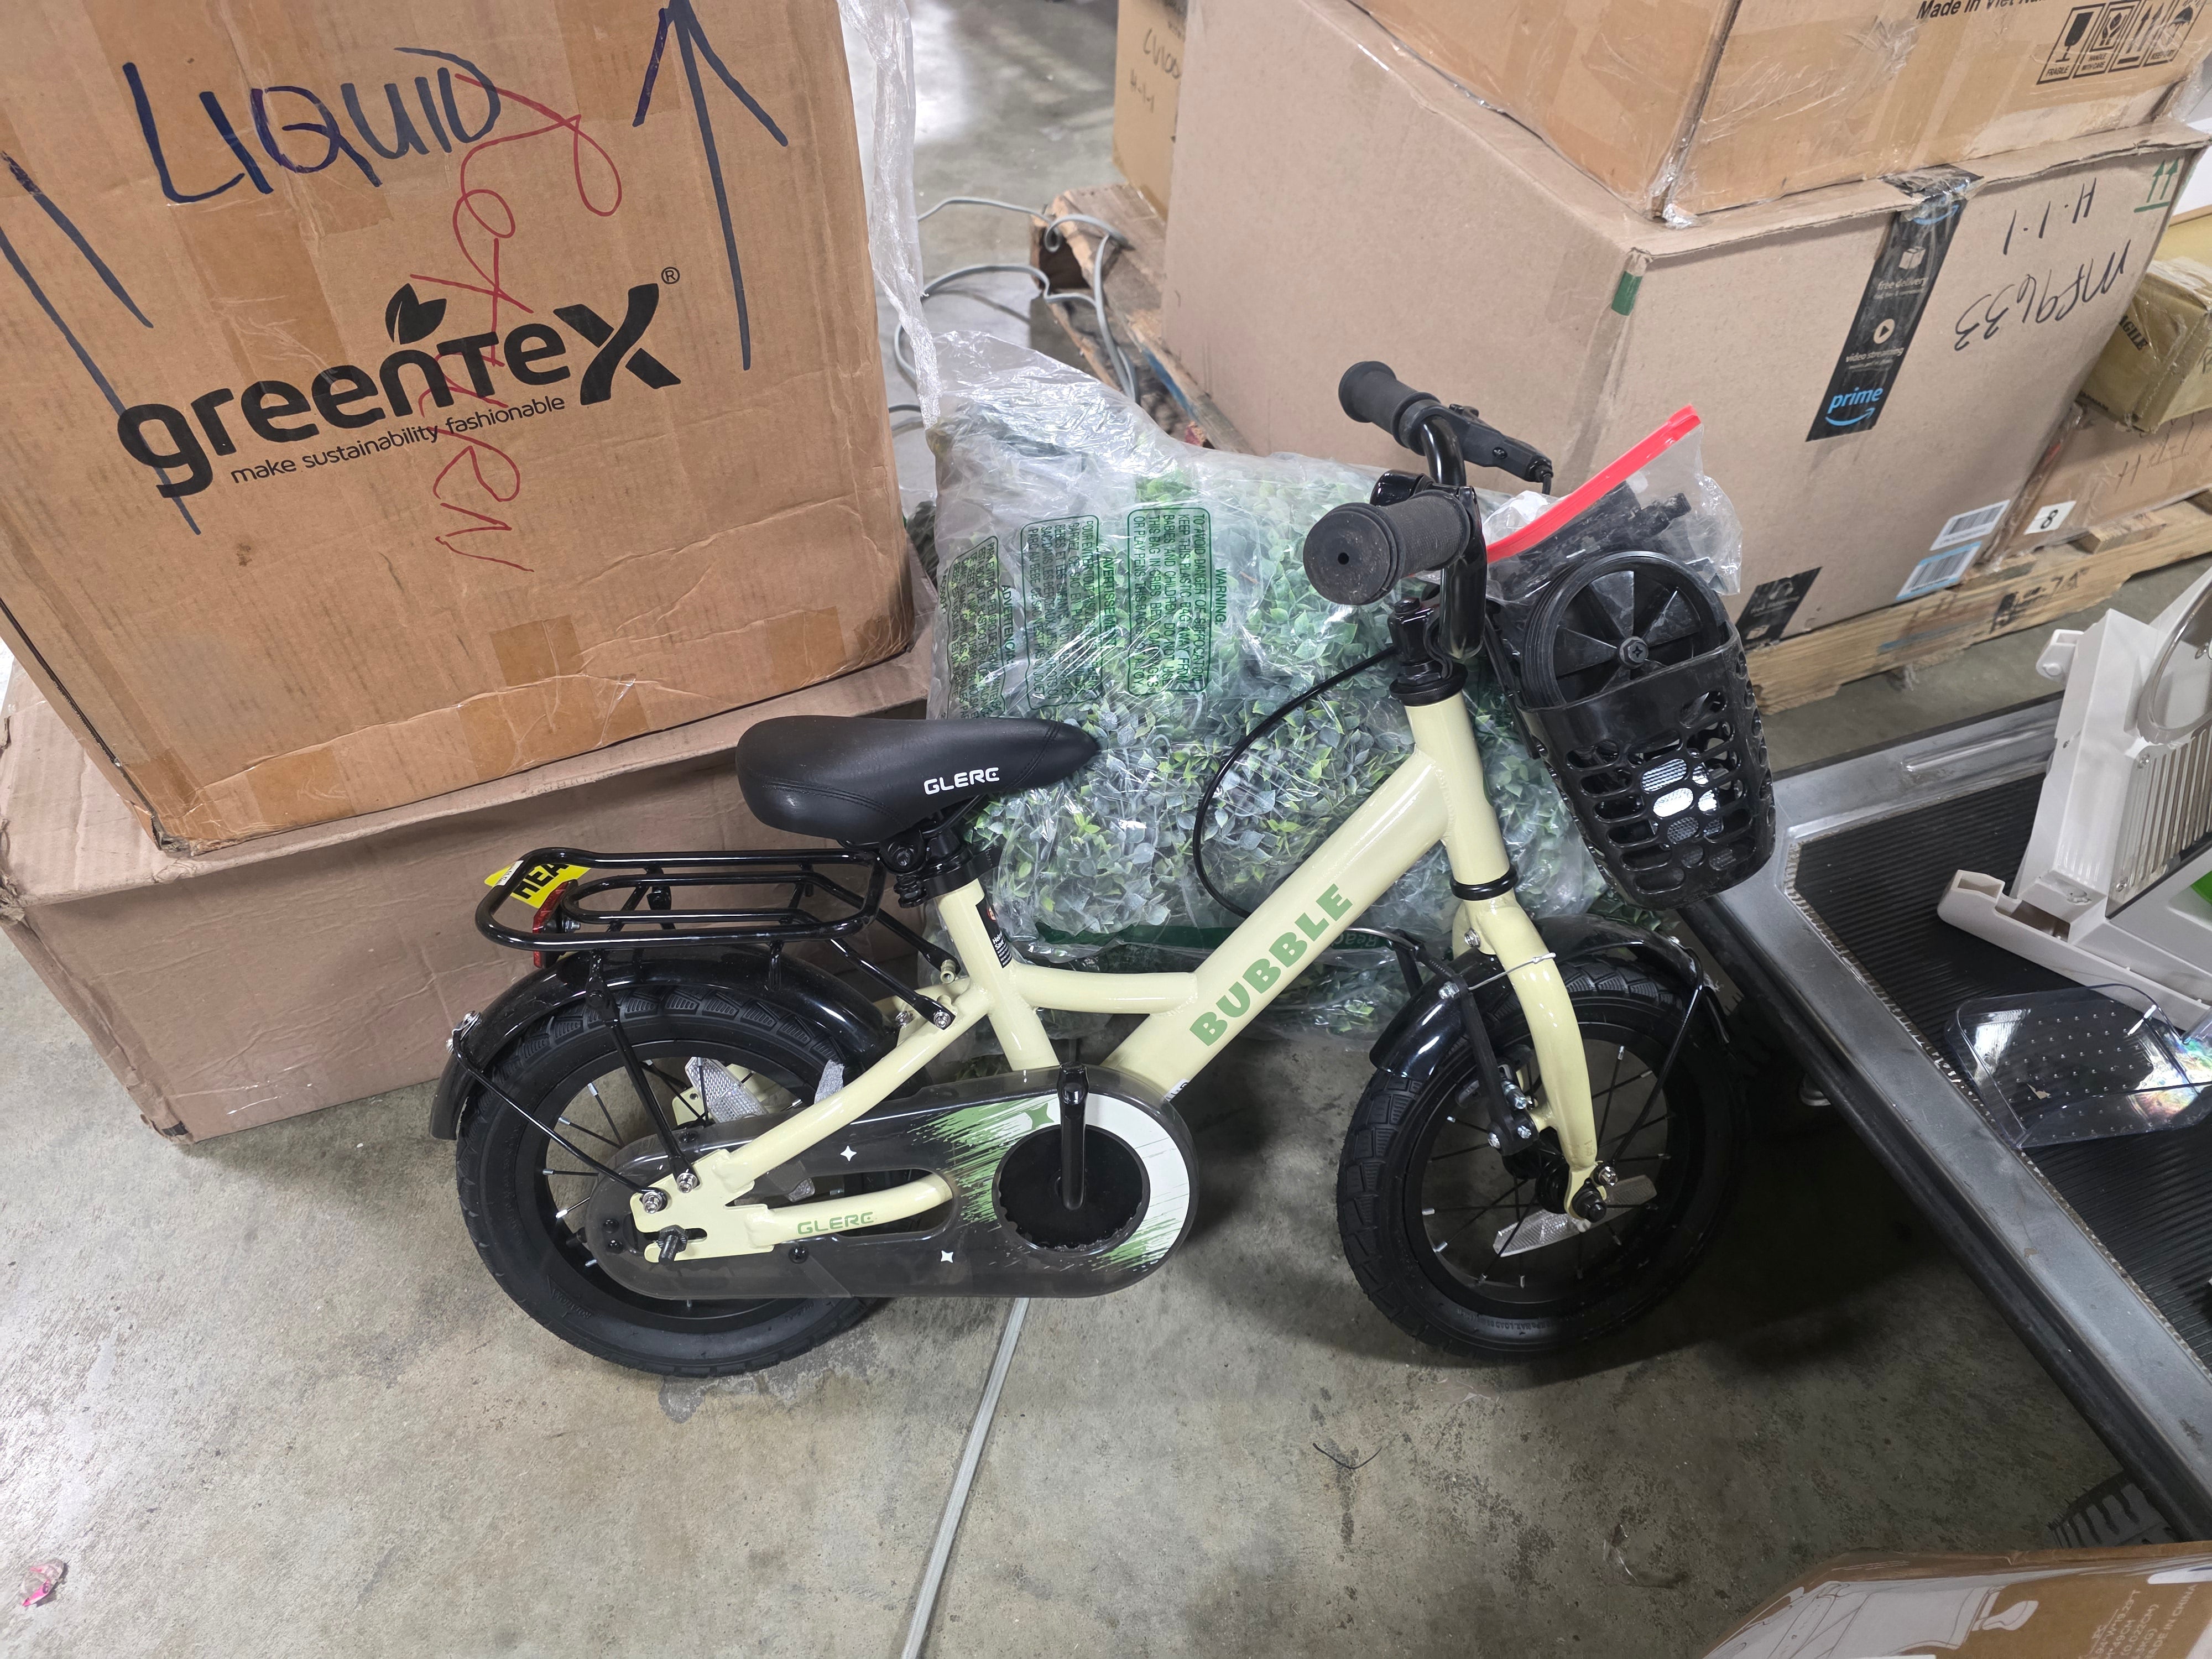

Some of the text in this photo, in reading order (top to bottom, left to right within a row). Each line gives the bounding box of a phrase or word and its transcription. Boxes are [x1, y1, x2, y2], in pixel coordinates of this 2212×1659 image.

[1916, 1, 1961, 19] Made
[2047, 65, 2070, 76] FRAGILE
[122, 46, 502, 205] LIQUID
[1845, 352, 1866, 363] video
[1827, 387, 1884, 414] prime
[230, 394, 566, 484] make sustainability fashionable
[1134, 517, 1145, 528] OR
[1149, 515, 1160, 534] THIS
[1193, 514, 1205, 524] TO
[2039, 509, 2059, 530] 8
[1041, 526, 1052, 541] SAC
[1068, 523, 1079, 551] GARDEZ
[1082, 521, 1093, 541] POUR
[1164, 515, 1175, 544] BABIES
[1028, 529, 1039, 550] PARC
[1134, 531, 1145, 550] PLAY
[1149, 537, 1160, 554] BAG
[1194, 529, 1206, 555] AVOID
[978, 547, 986, 566] ESTA
[1041, 543, 1053, 565] DANS
[1056, 551, 1066, 561] ET
[1069, 556, 1080, 567] CE
[1149, 559, 1160, 567] IN
[1164, 549, 1176, 566] AND
[986, 562, 995, 589] EVITAR
[1042, 566, 1053, 580] LES
[1056, 565, 1067, 580] LES
[1134, 554, 1145, 579] PENS.
[977, 566, 985, 590] BOLSA
[1070, 572, 1081, 588] SAC
[1083, 572, 1094, 593] TOUT
[1194, 559, 1206, 594] DANGER
[977, 592, 985, 604] DE
[987, 589, 996, 599] EL
[1070, 593, 1081, 604] EN
[1177, 514, 1191, 684] KEEP THIS PLASTIC BAG AWAY FROM
[1215, 568, 1227, 625] WARNING:
[1031, 600, 1043, 617] SAC
[1135, 604, 1146, 624] BAG
[1194, 599, 1206, 613] OF
[987, 599, 998, 632] PELIGRO
[989, 632, 998, 643] DE
[1032, 619, 1045, 642] N'EST
[1164, 623, 1175, 636] DO
[951, 642, 959, 653] ES
[968, 639, 978, 661] USAR
[978, 642, 987, 665] FUERA
[1035, 643, 1045, 659] PAS
[1163, 642, 1174, 660] NOT
[951, 653, 959, 665] UN
[969, 684, 980, 709] BOLSA
[1048, 689, 1058, 700] OU
[1062, 687, 1073, 698] CE
[1189, 883, 1353, 1047] BUBBLE
